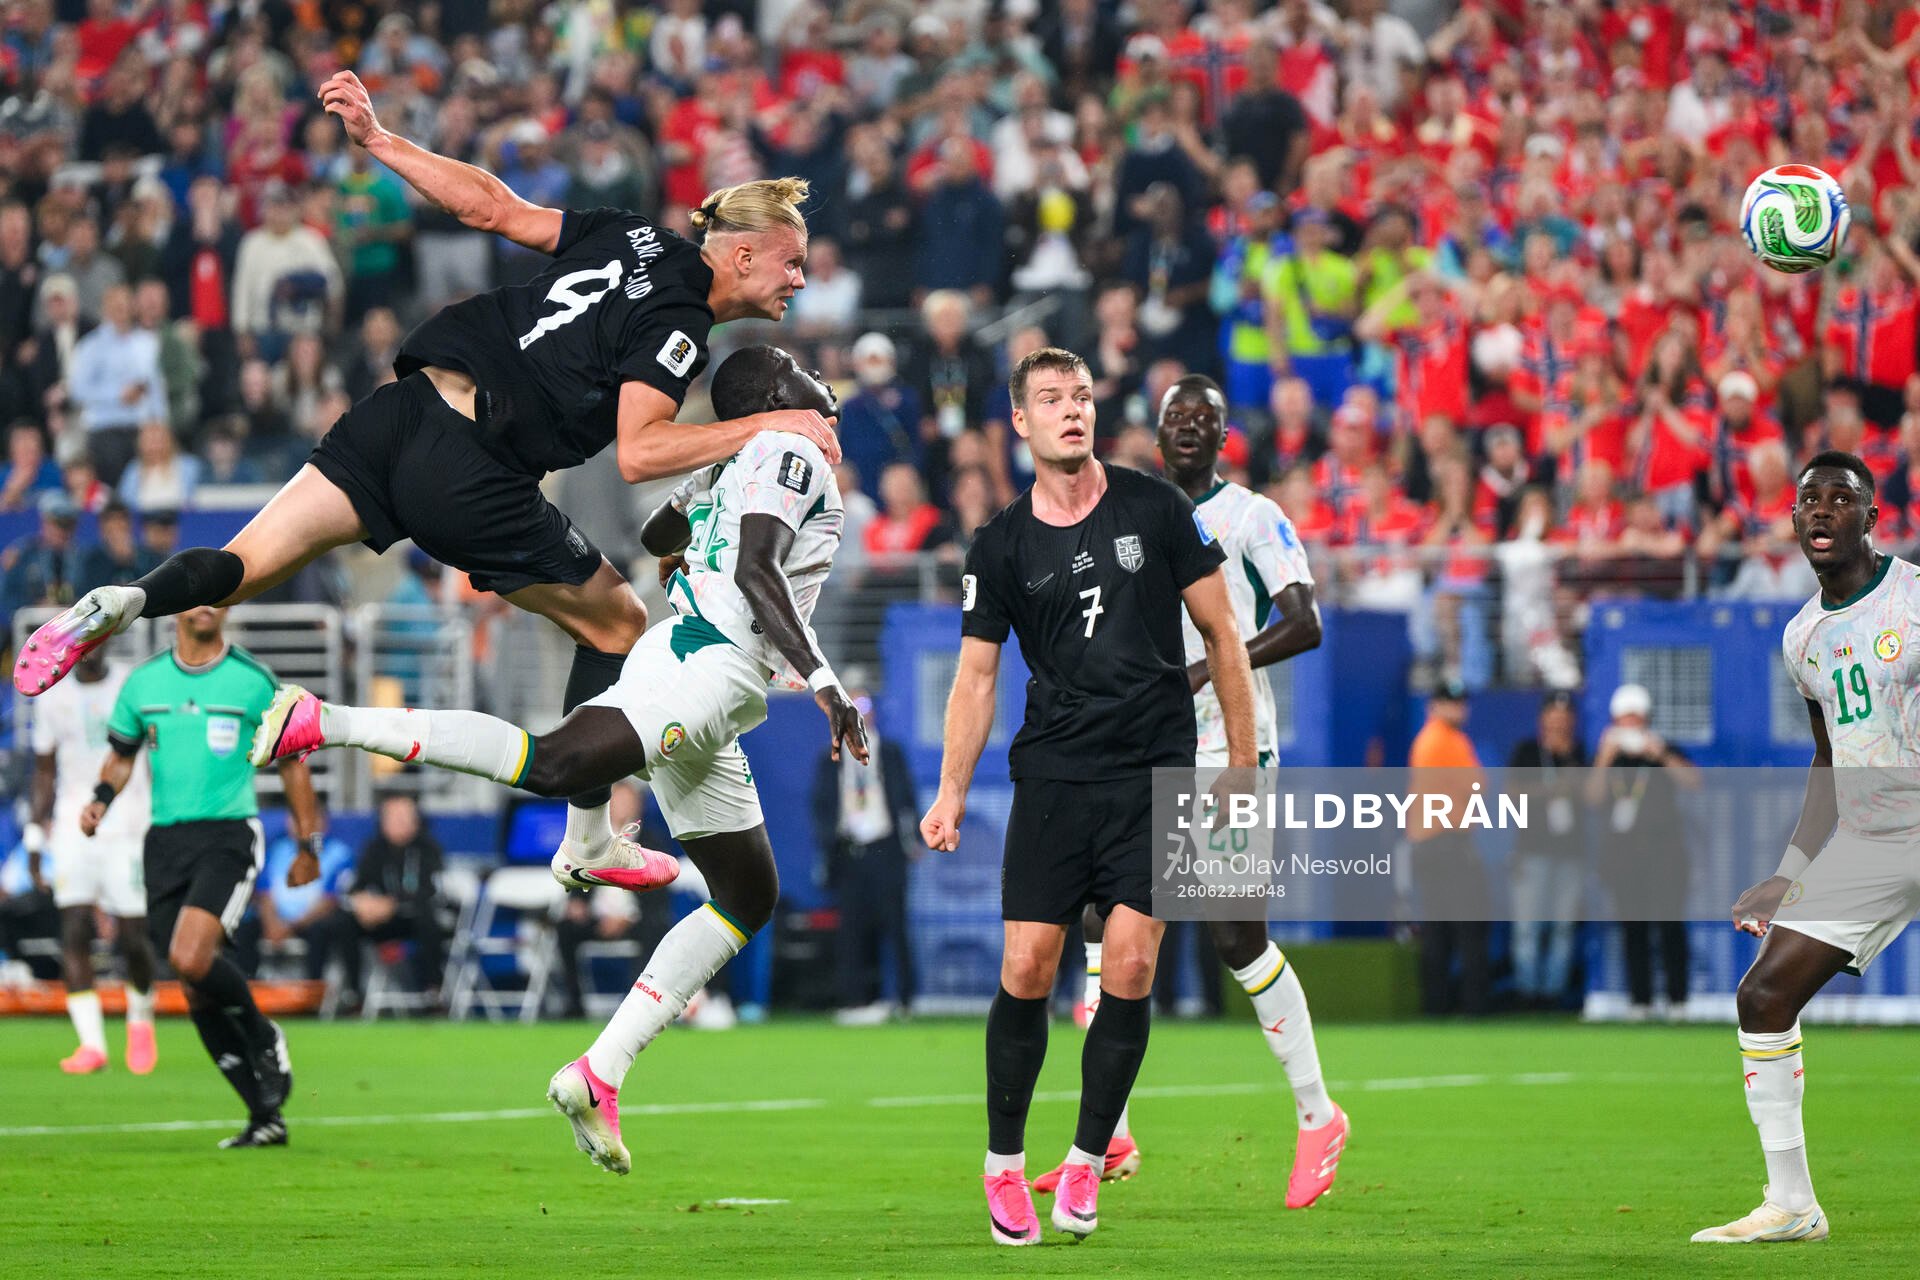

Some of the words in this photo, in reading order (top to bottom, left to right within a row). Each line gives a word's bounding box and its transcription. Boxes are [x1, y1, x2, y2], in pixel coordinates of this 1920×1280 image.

[1079, 586, 1104, 638] 7
[1832, 663, 1872, 725] 19
[1162, 832, 1186, 881] 7
